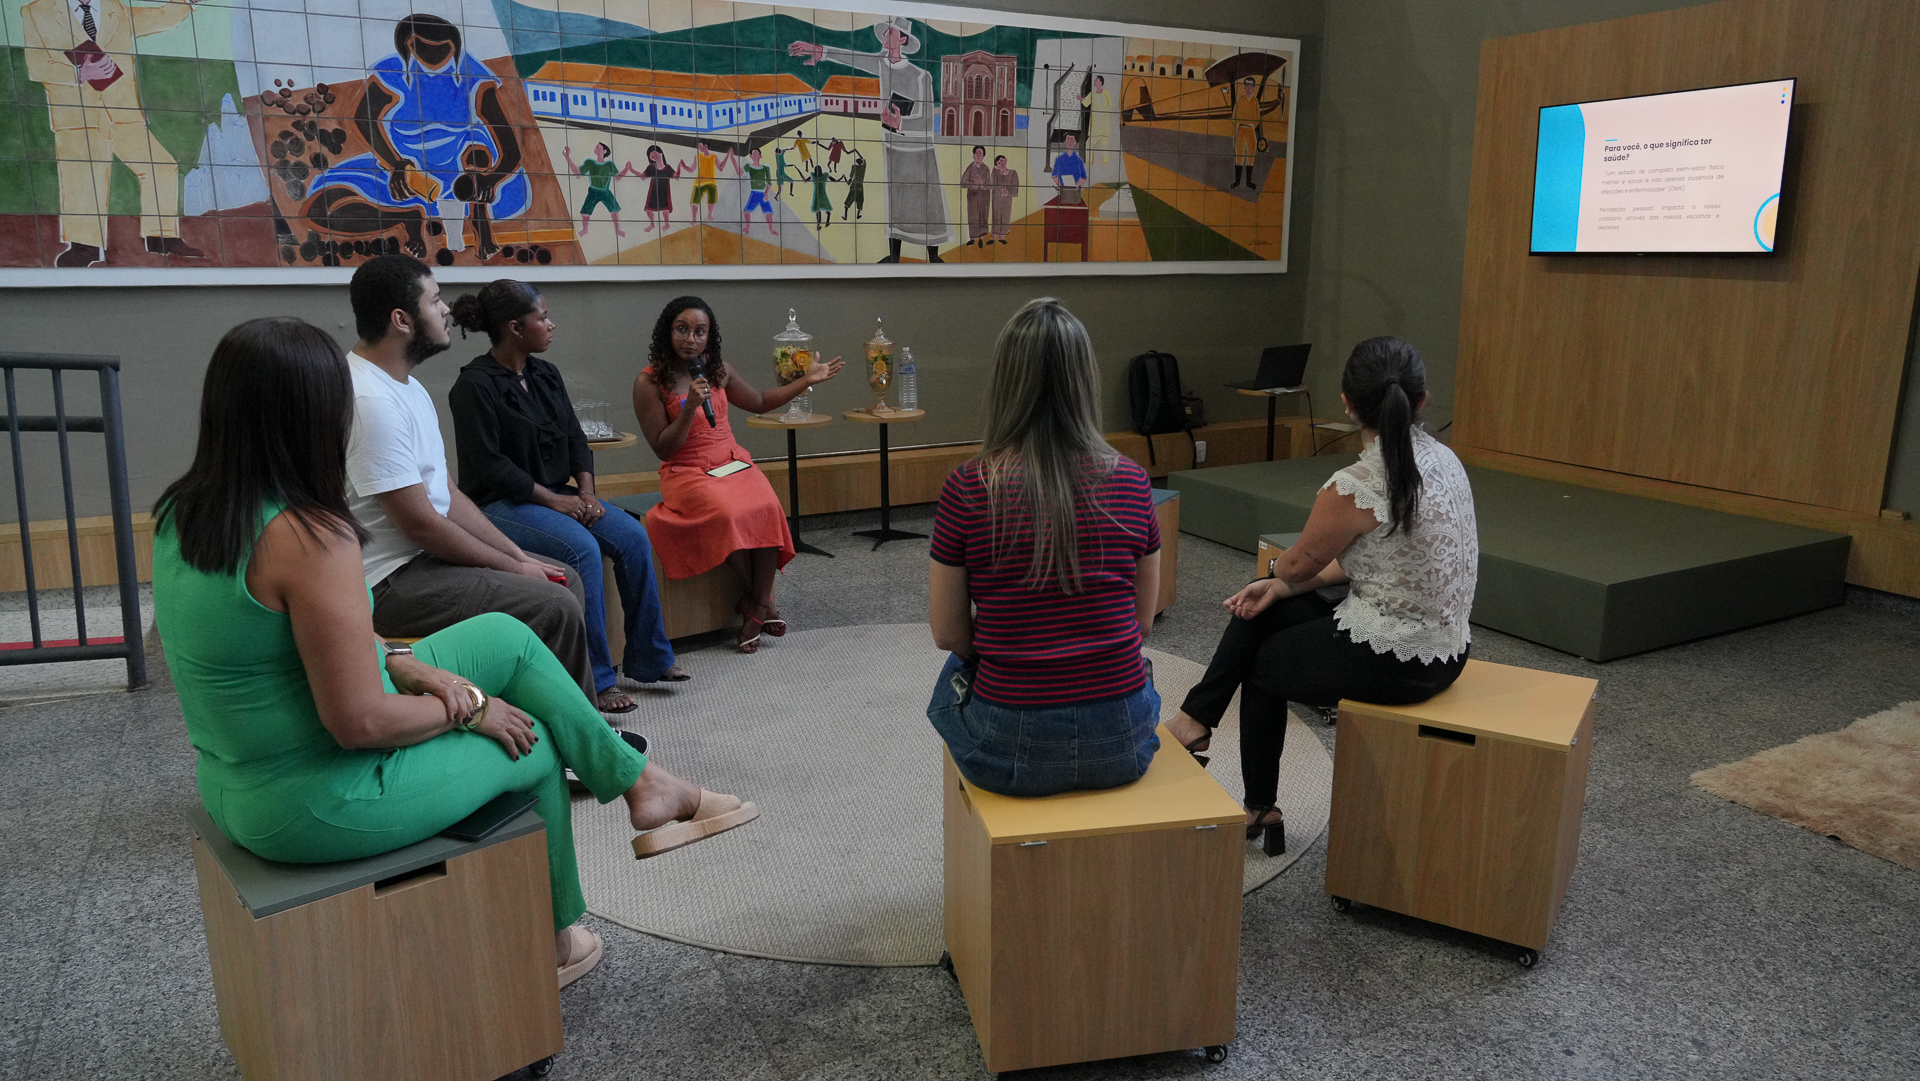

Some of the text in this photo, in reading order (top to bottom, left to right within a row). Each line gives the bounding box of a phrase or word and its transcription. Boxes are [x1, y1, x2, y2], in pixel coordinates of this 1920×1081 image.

[1622, 143, 1642, 151] você,
[1649, 142, 1664, 150] que
[1665, 138, 1699, 149] significa
[1603, 153, 1630, 162] saúde?
[1648, 167, 1674, 175] completo
[1676, 164, 1707, 172] bem-estar
[1664, 176, 1685, 184] apenas
